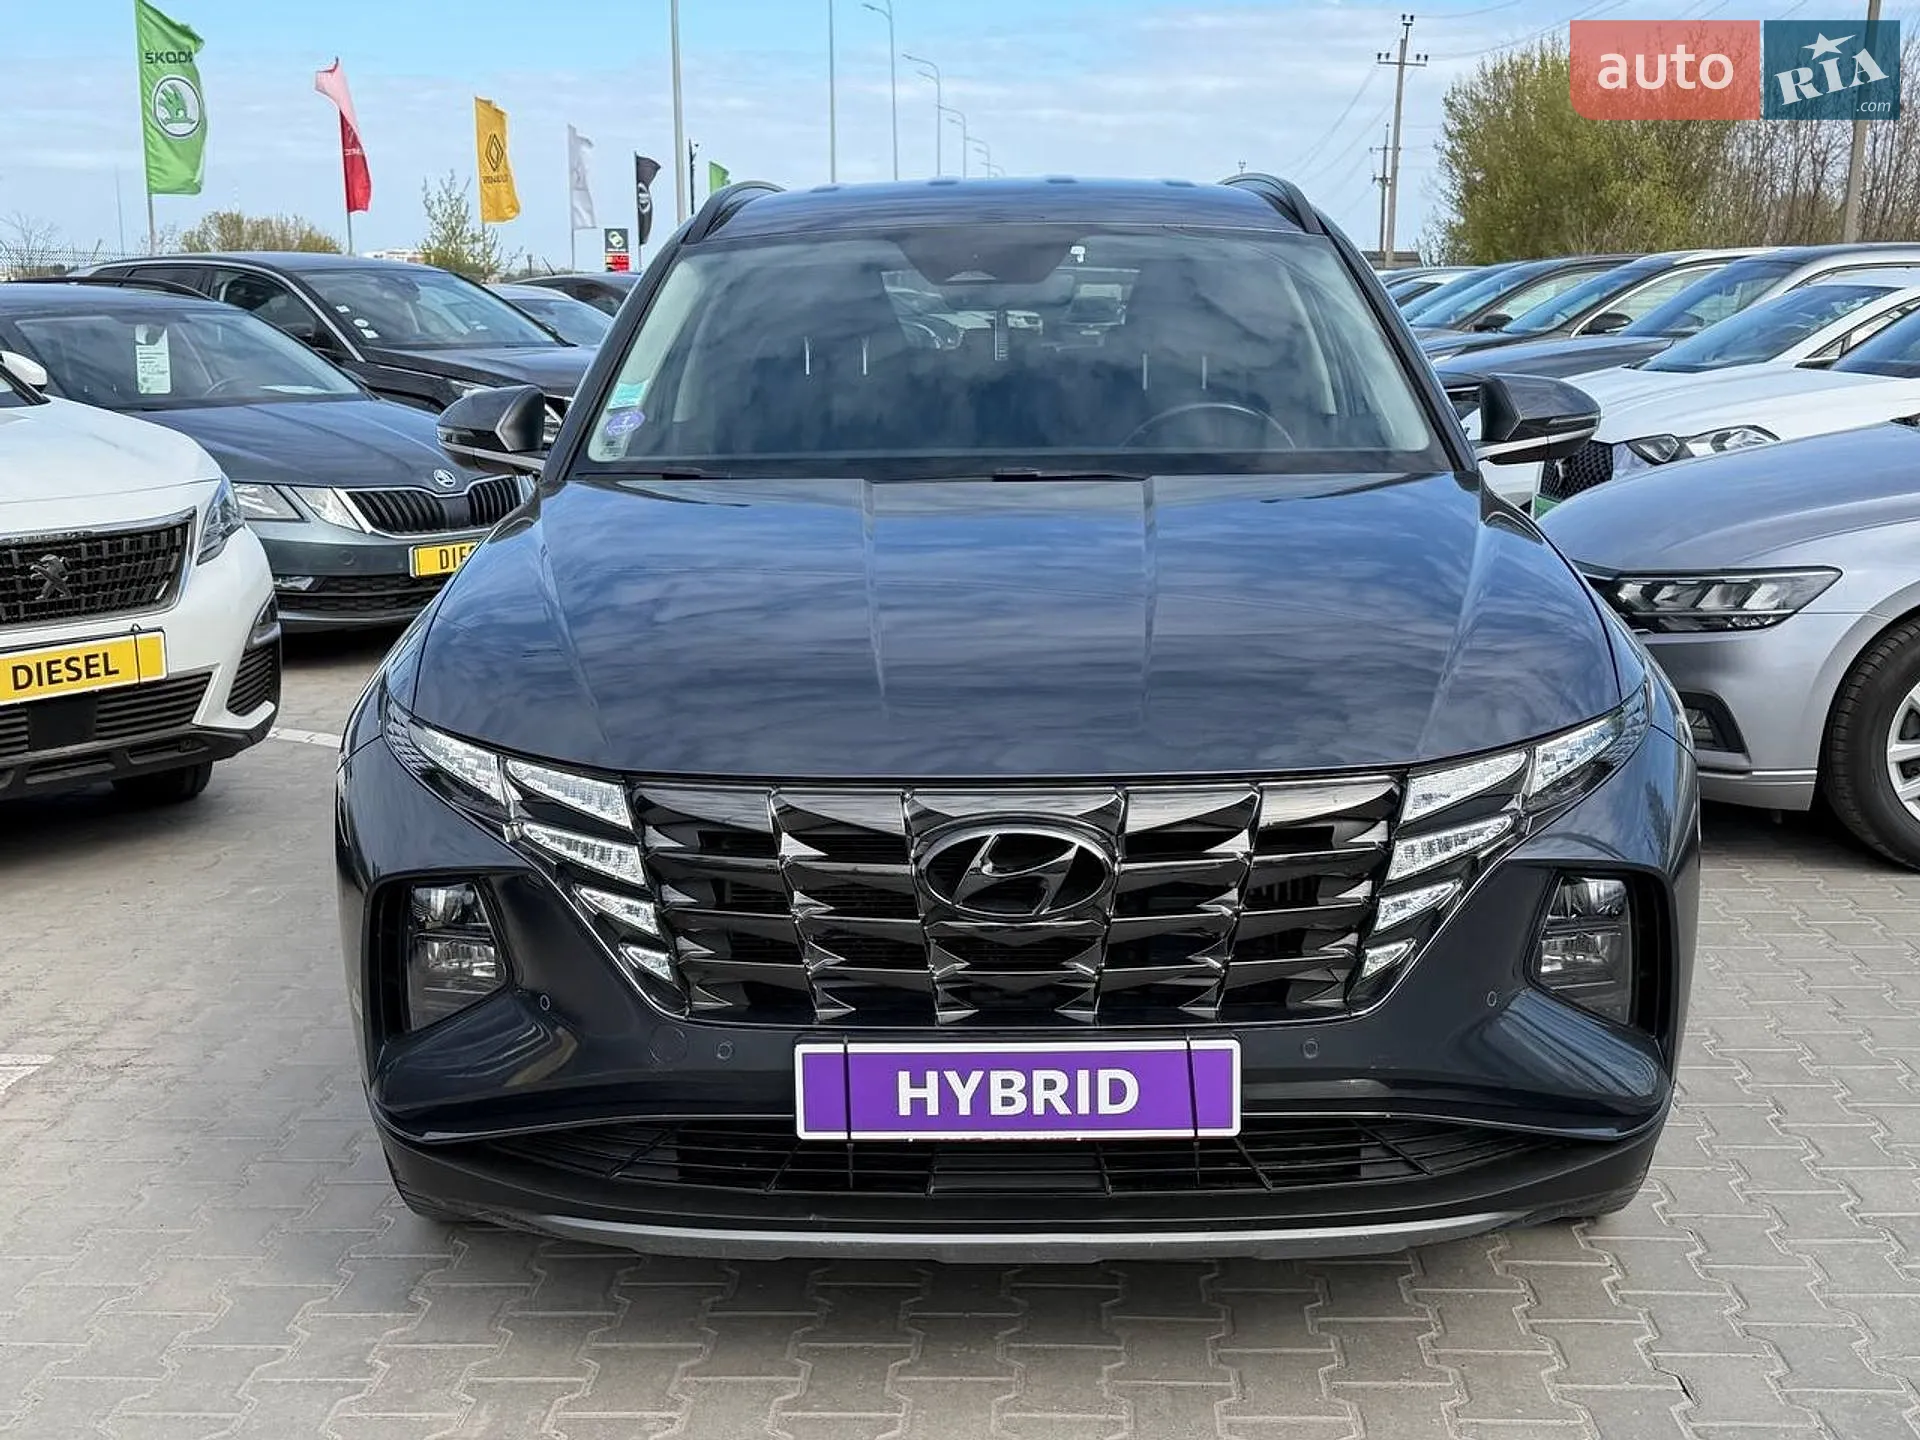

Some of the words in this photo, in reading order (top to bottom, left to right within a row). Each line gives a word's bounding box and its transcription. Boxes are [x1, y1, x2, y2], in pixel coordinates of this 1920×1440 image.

[439, 545, 475, 569] DIE
[11, 651, 120, 691] DIESEL
[897, 1069, 1139, 1116] HYBRID
